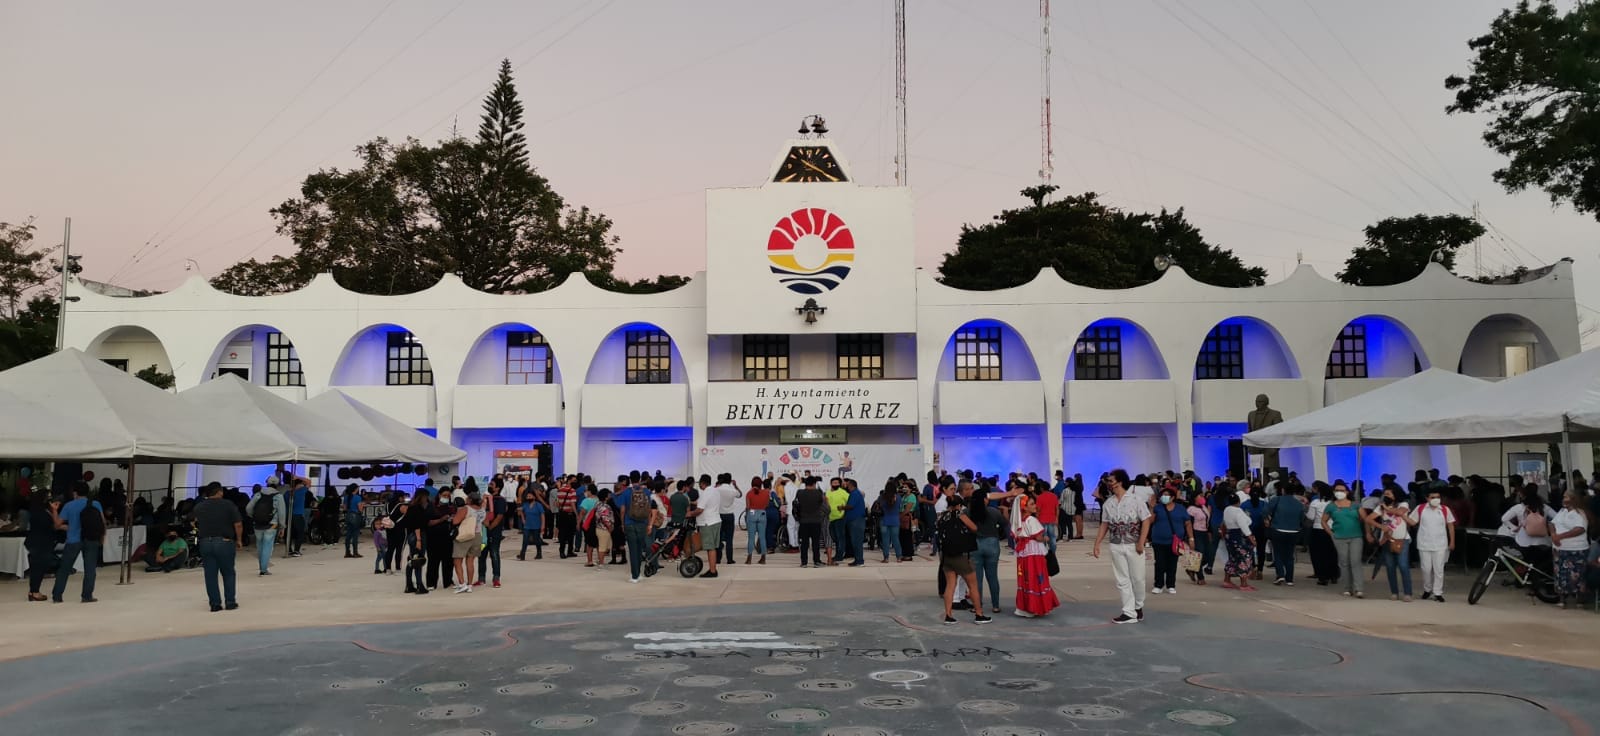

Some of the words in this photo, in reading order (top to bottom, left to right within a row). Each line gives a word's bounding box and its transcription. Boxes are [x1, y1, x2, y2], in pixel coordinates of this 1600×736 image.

[756, 387, 769, 398] H.
[774, 387, 870, 400] Ayuntamiento
[726, 404, 803, 420] BENITO
[815, 403, 901, 418] JUAREZ
